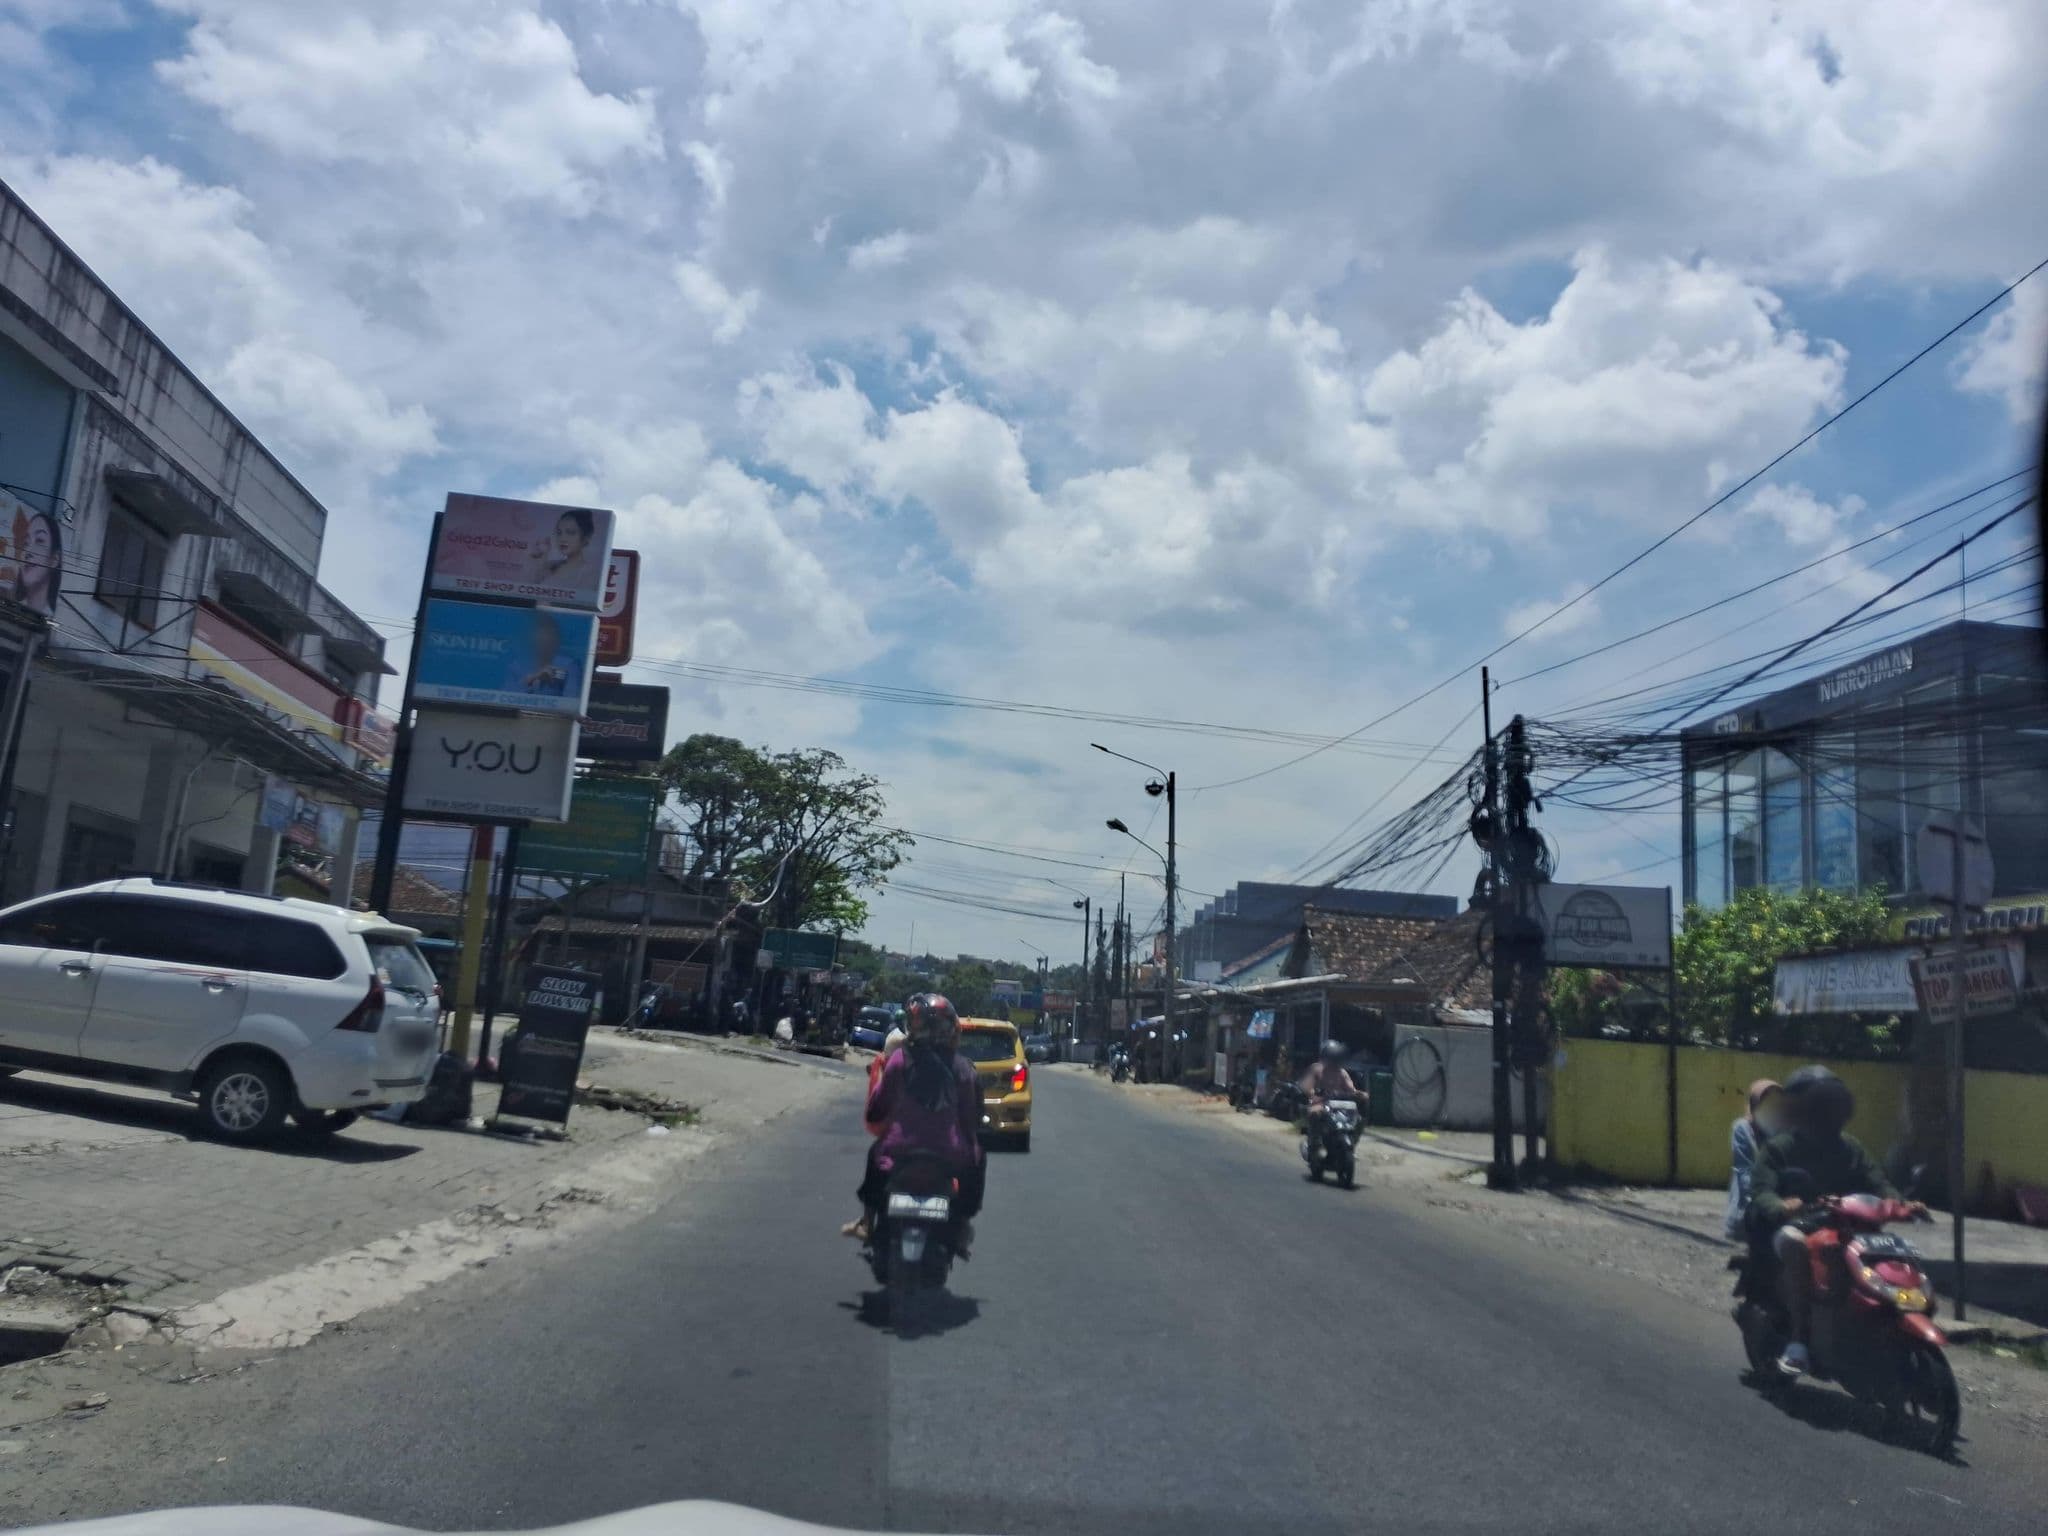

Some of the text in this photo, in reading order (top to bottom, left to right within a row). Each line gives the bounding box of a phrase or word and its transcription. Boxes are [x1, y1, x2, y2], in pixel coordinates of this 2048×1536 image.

[518, 585, 577, 600] COSMETIC
[440, 736, 542, 775] Y.O.U
[540, 977, 587, 995] SLOW
